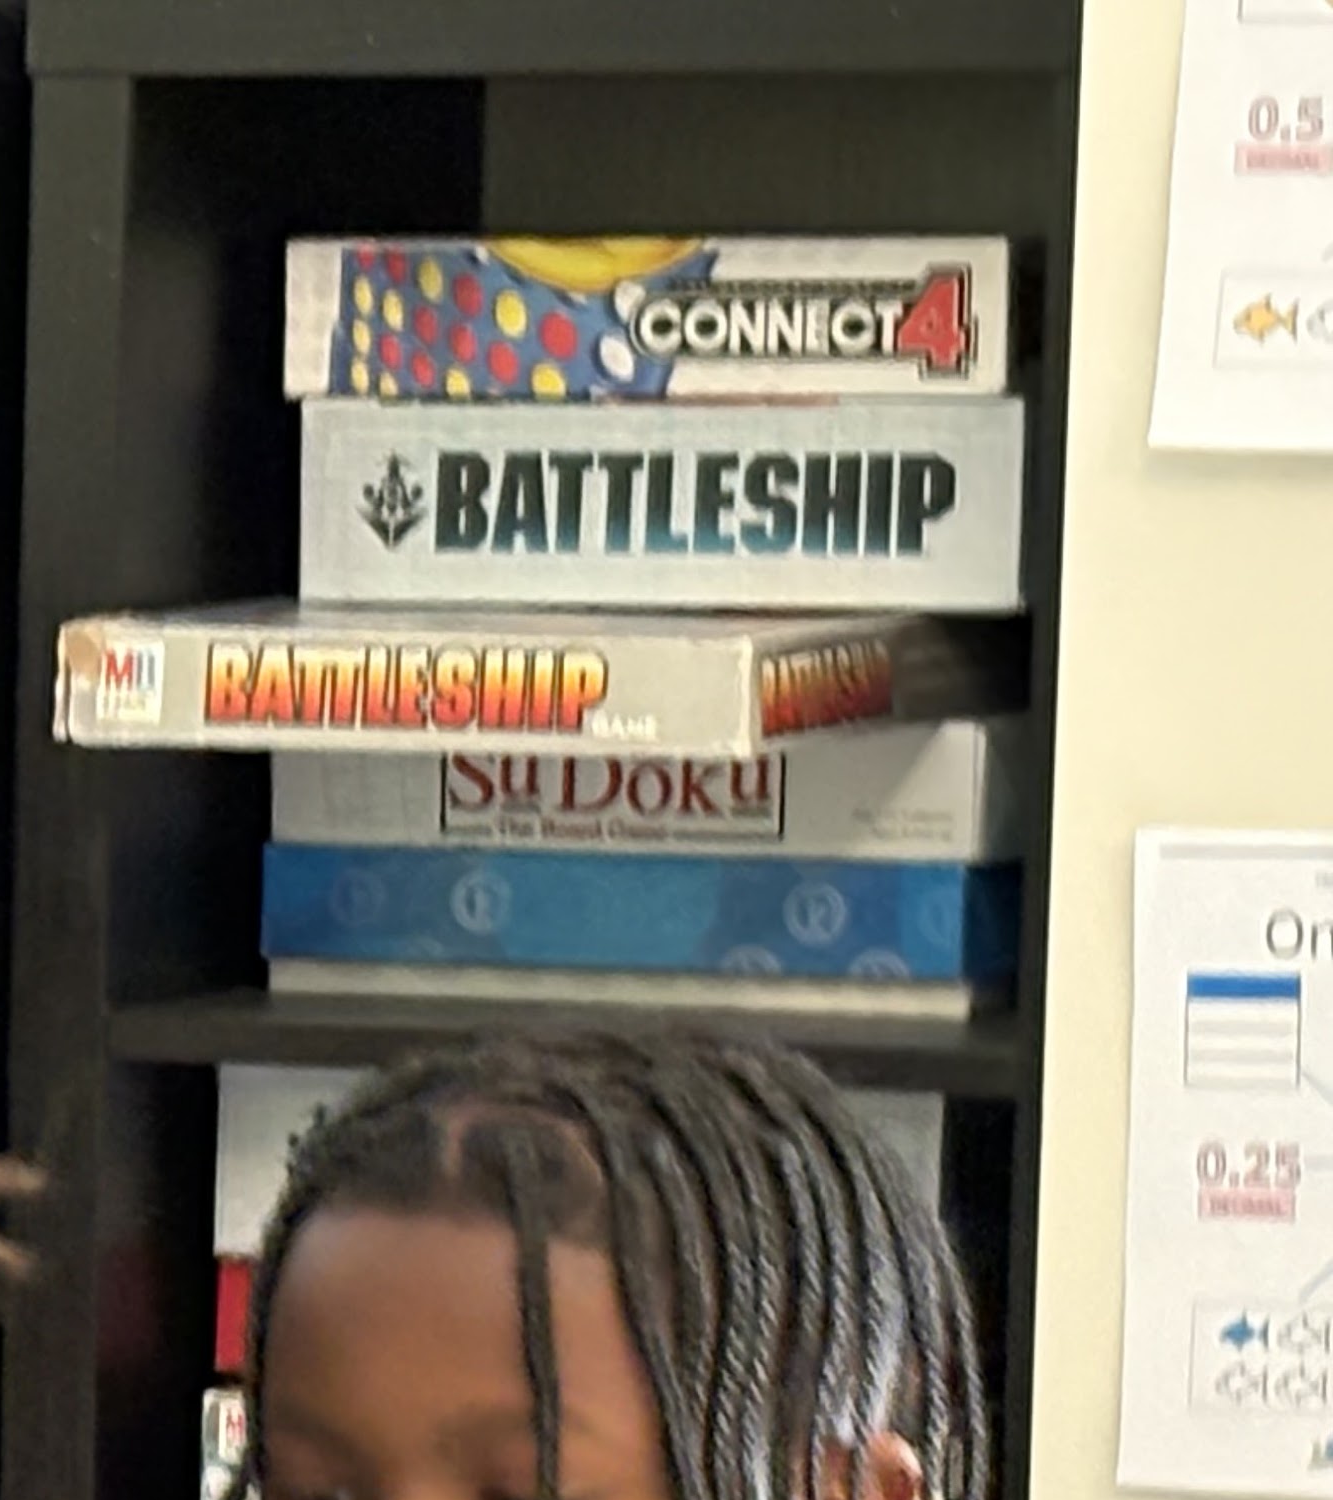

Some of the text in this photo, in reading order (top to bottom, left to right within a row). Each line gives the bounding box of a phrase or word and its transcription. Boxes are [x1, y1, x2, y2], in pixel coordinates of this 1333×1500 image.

[1247, 94, 1325, 143] 0.5
[633, 264, 975, 376] CONNECT 4
[433, 450, 958, 557] BATTLESHIP
[204, 638, 610, 735] BATTLESHIP
[1195, 1140, 1302, 1189] 0.25
